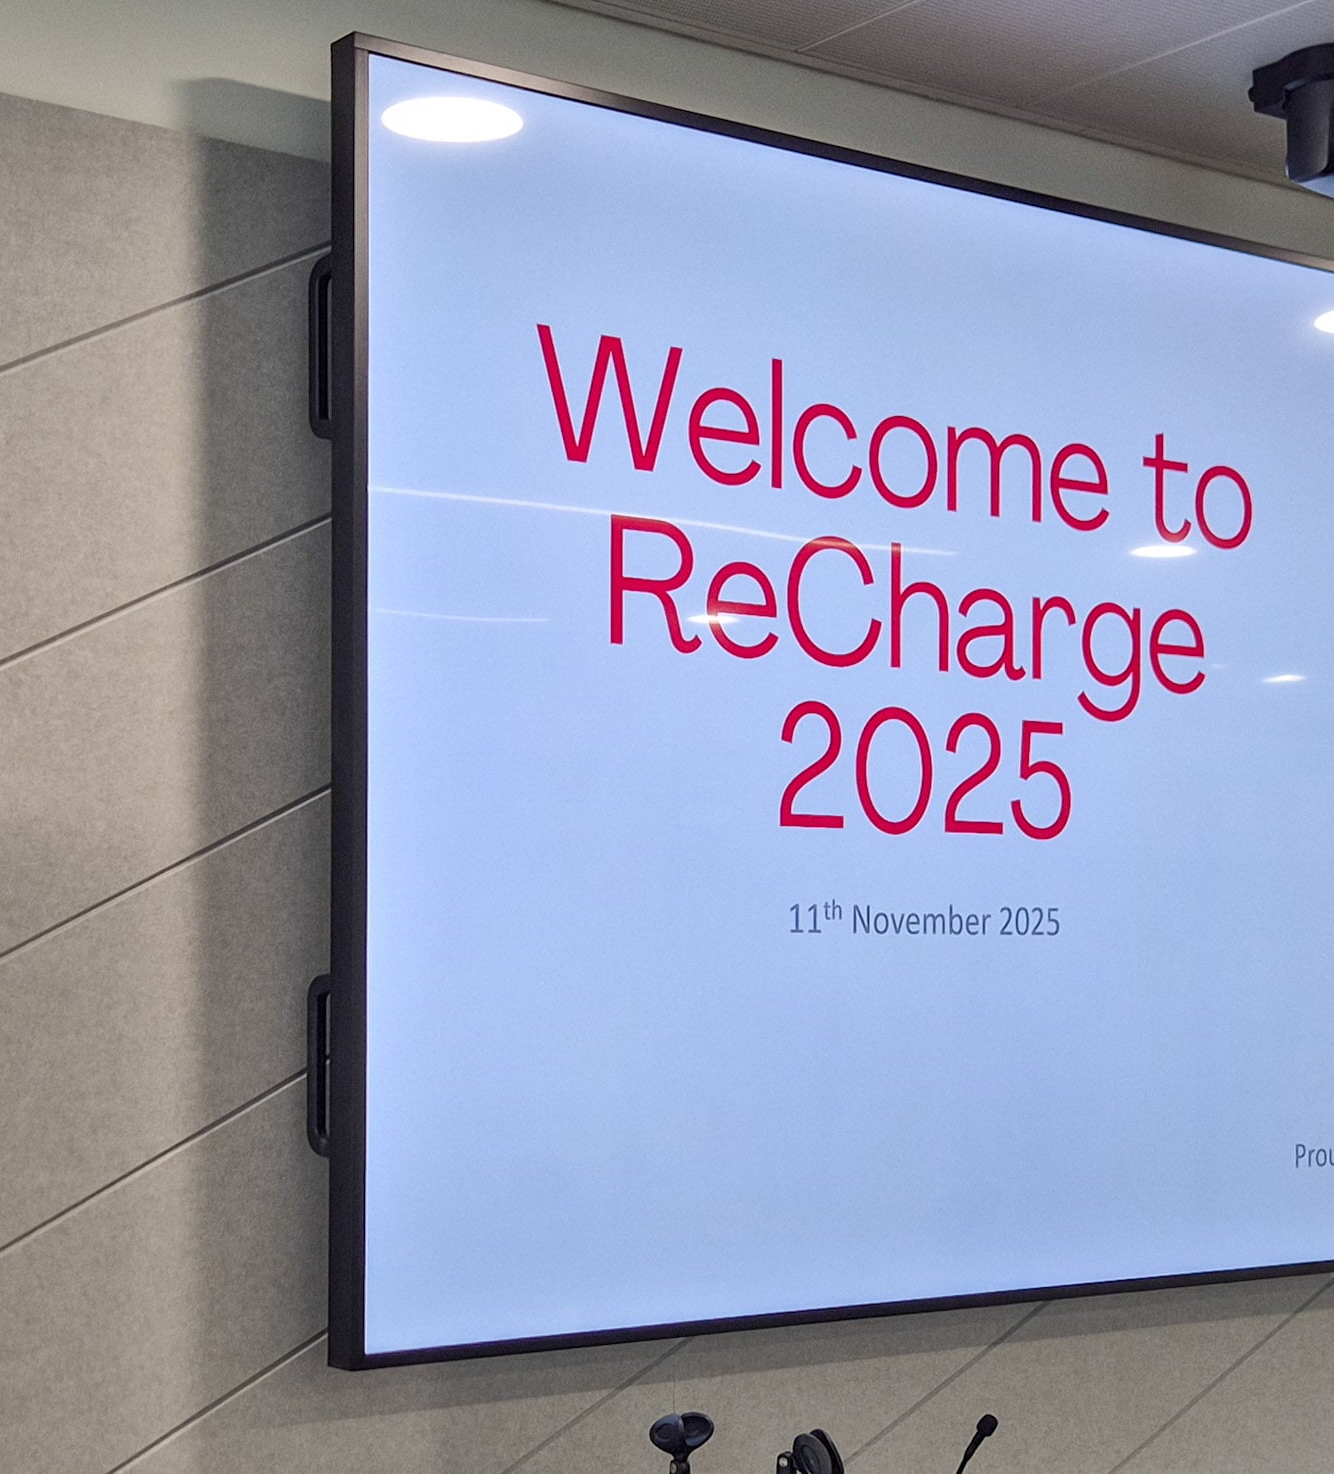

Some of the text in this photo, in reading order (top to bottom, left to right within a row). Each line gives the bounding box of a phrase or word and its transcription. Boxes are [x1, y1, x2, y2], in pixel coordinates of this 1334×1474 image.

[537, 323, 1253, 549] Welcome to
[608, 513, 1208, 722] ReCharge
[779, 701, 1072, 841] 2025
[789, 898, 1060, 936] 11th November 2025
